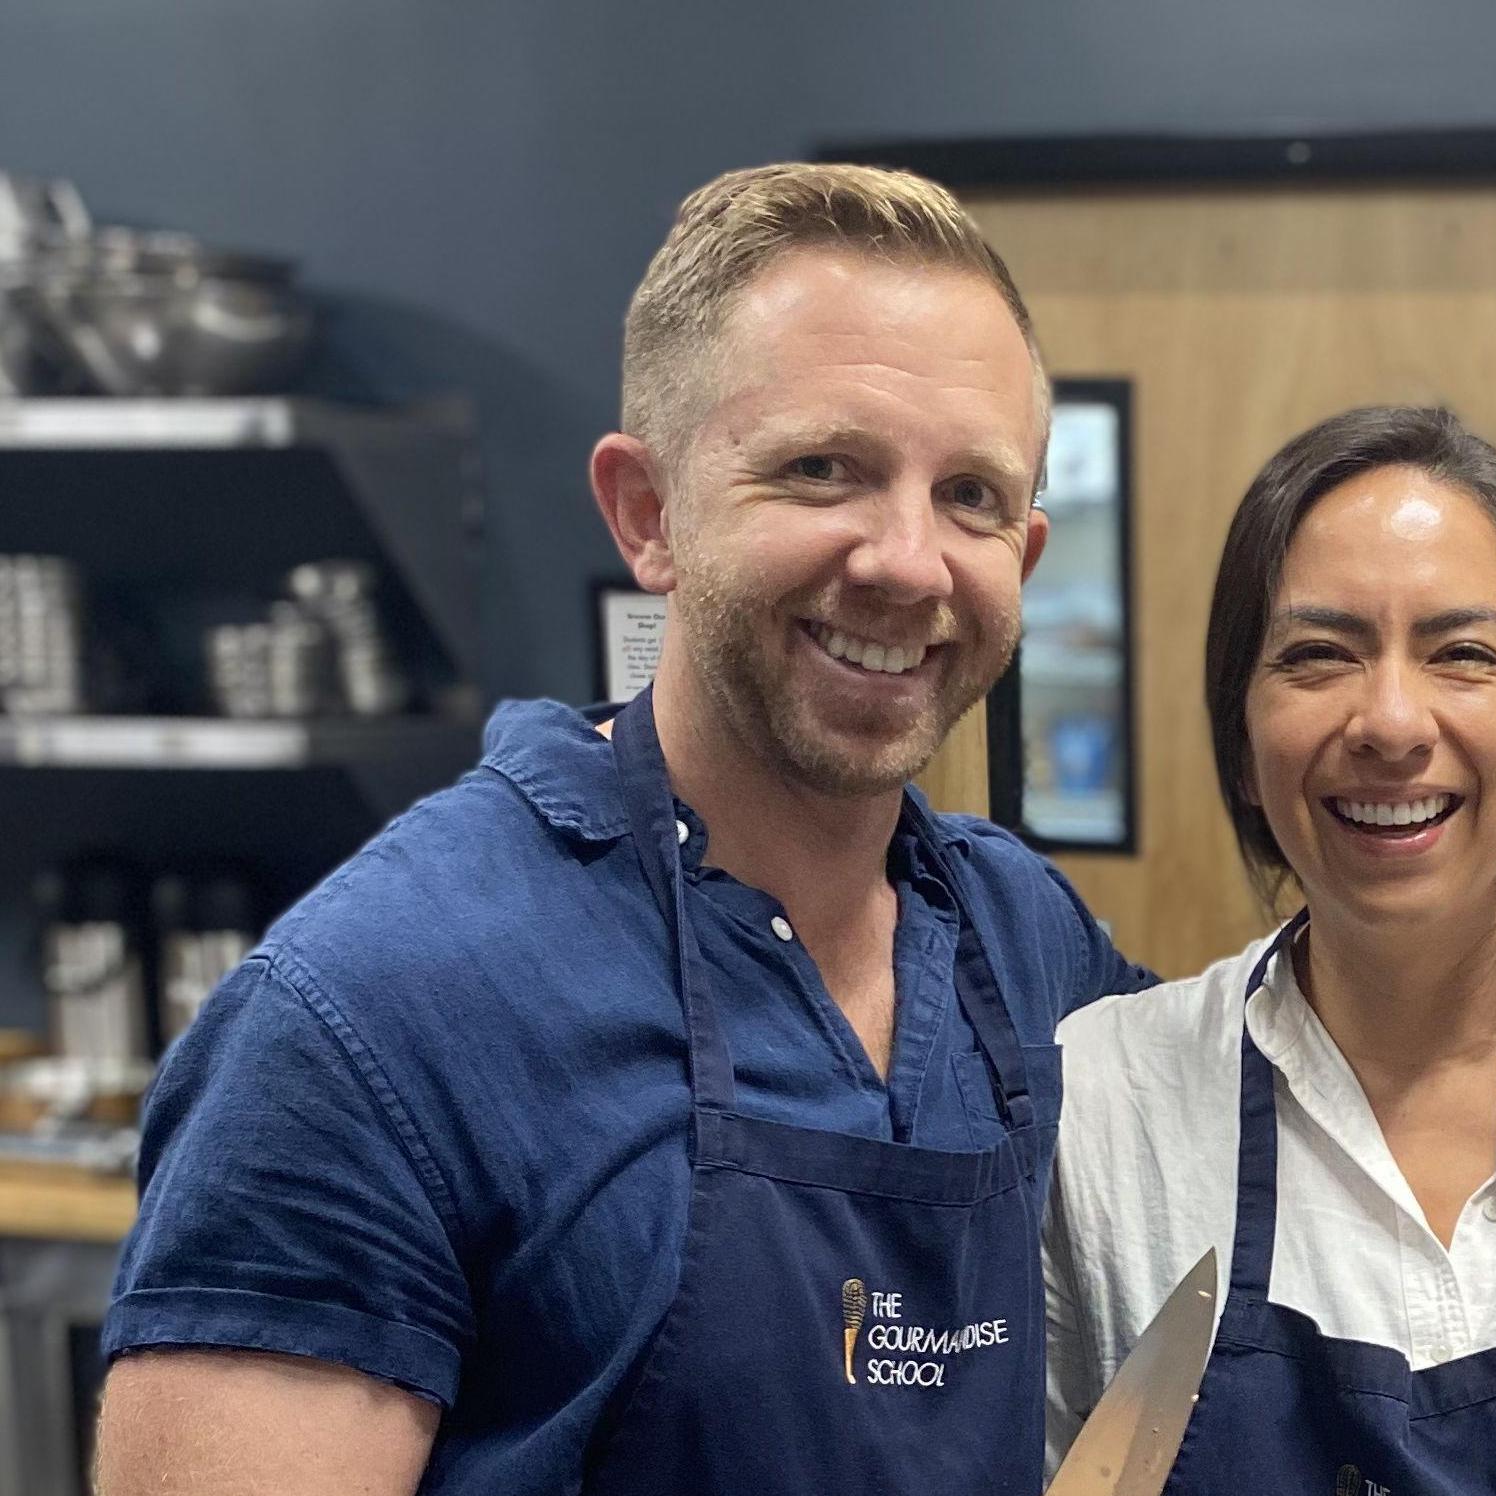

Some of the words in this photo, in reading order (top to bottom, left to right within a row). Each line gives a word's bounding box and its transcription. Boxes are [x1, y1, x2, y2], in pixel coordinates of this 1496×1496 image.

[871, 1291, 902, 1319] THE
[868, 1319, 1009, 1355] GOURMANDISE
[866, 1358, 945, 1387] SCHOOL
